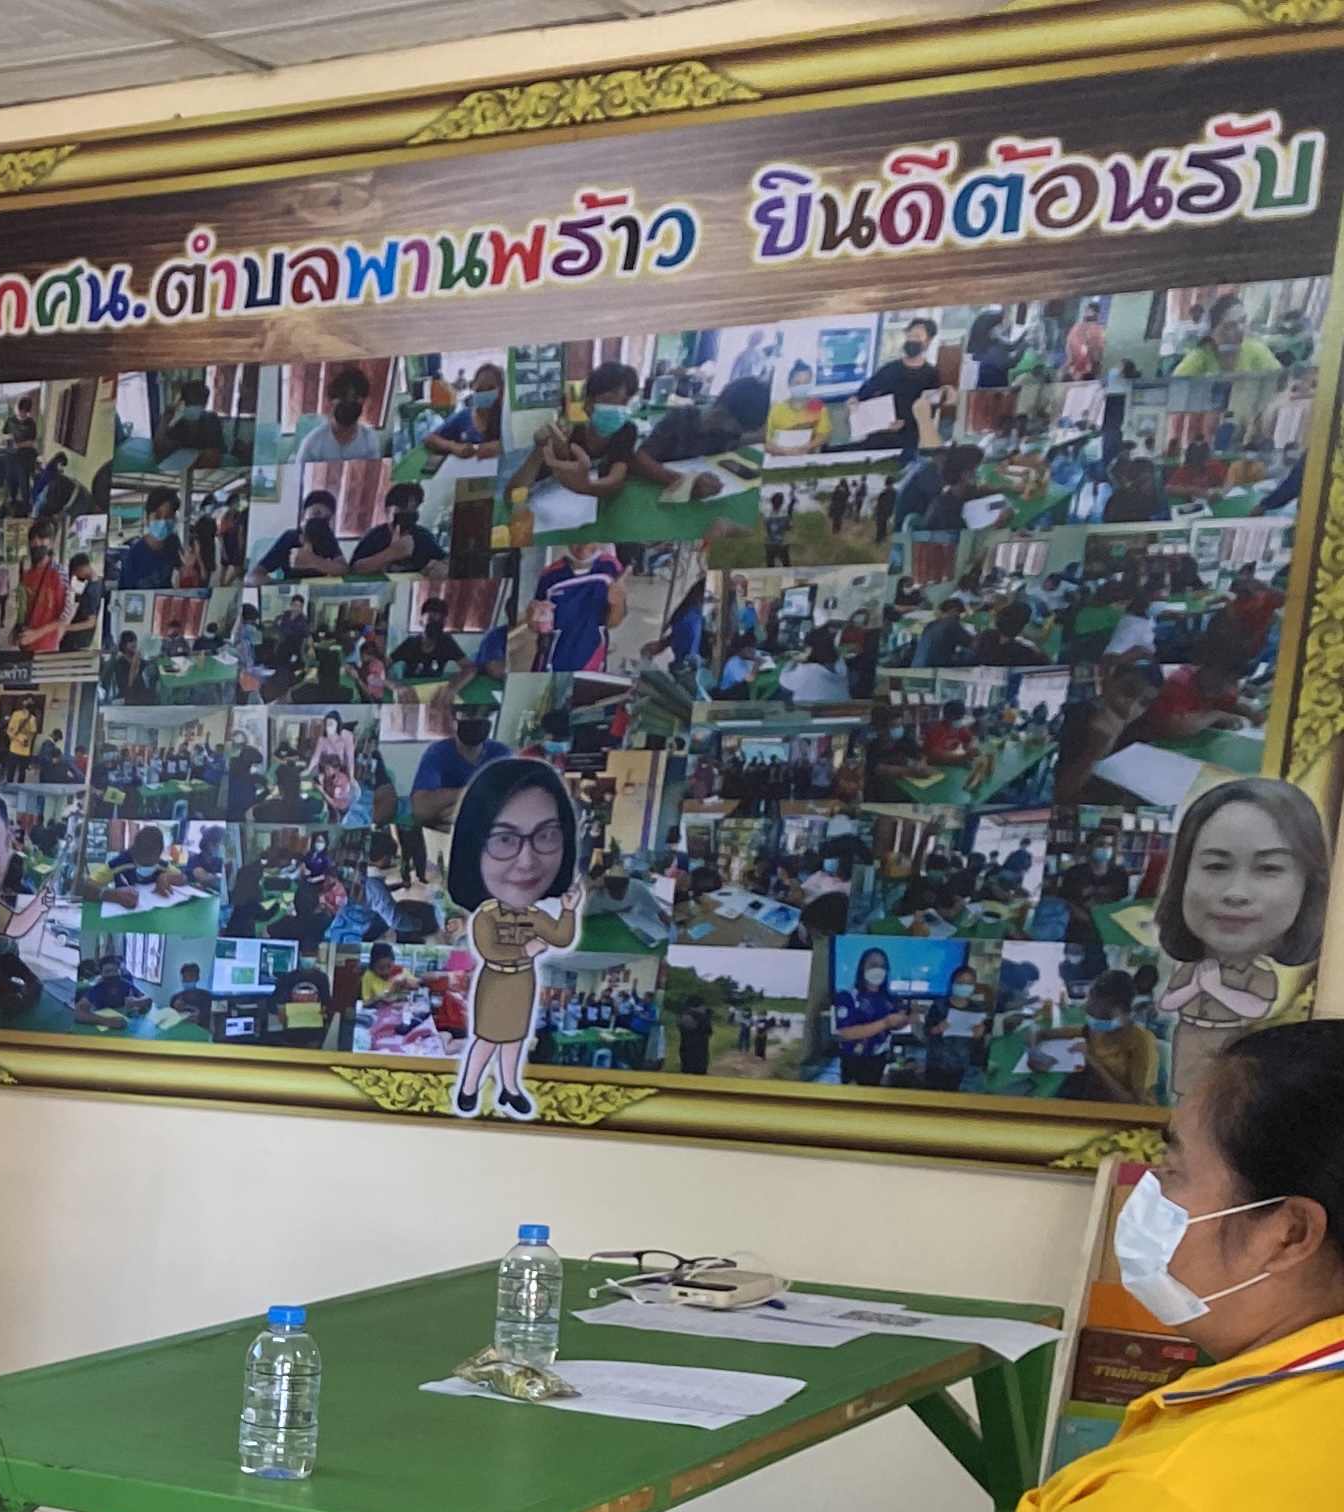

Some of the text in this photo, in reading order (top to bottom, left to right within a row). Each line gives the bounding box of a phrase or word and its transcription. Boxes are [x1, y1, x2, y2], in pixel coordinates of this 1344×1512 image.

[753, 115, 1318, 259] ยินดีต้อนรับ
